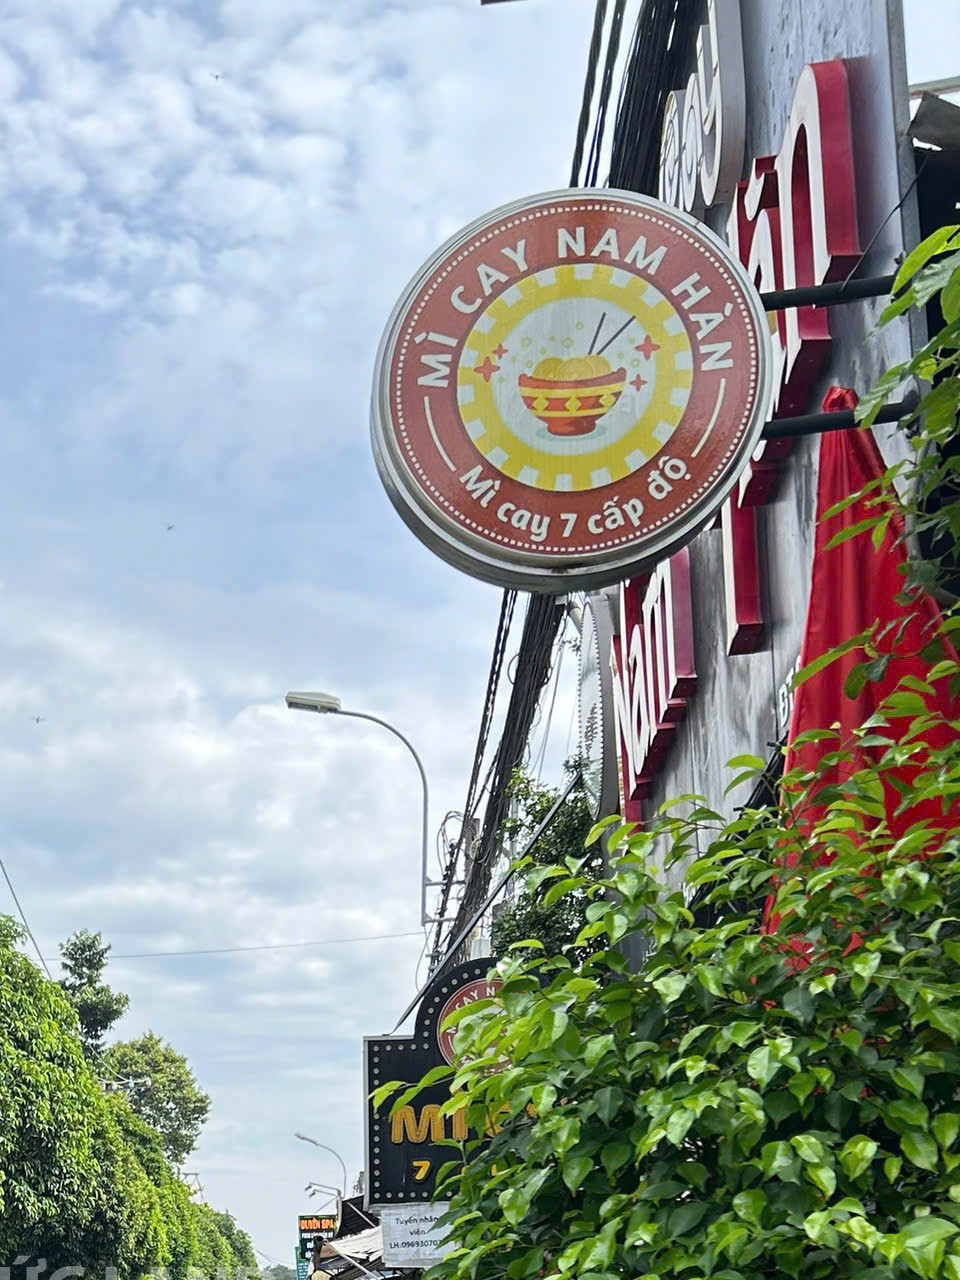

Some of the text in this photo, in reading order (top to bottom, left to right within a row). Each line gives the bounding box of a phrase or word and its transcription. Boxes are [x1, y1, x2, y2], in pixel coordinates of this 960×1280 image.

[414, 226, 735, 388] MÌ CAY NAM HÀN
[459, 455, 692, 541] Mì cay 7 cấp độ
[411, 1159, 431, 1181] 7
